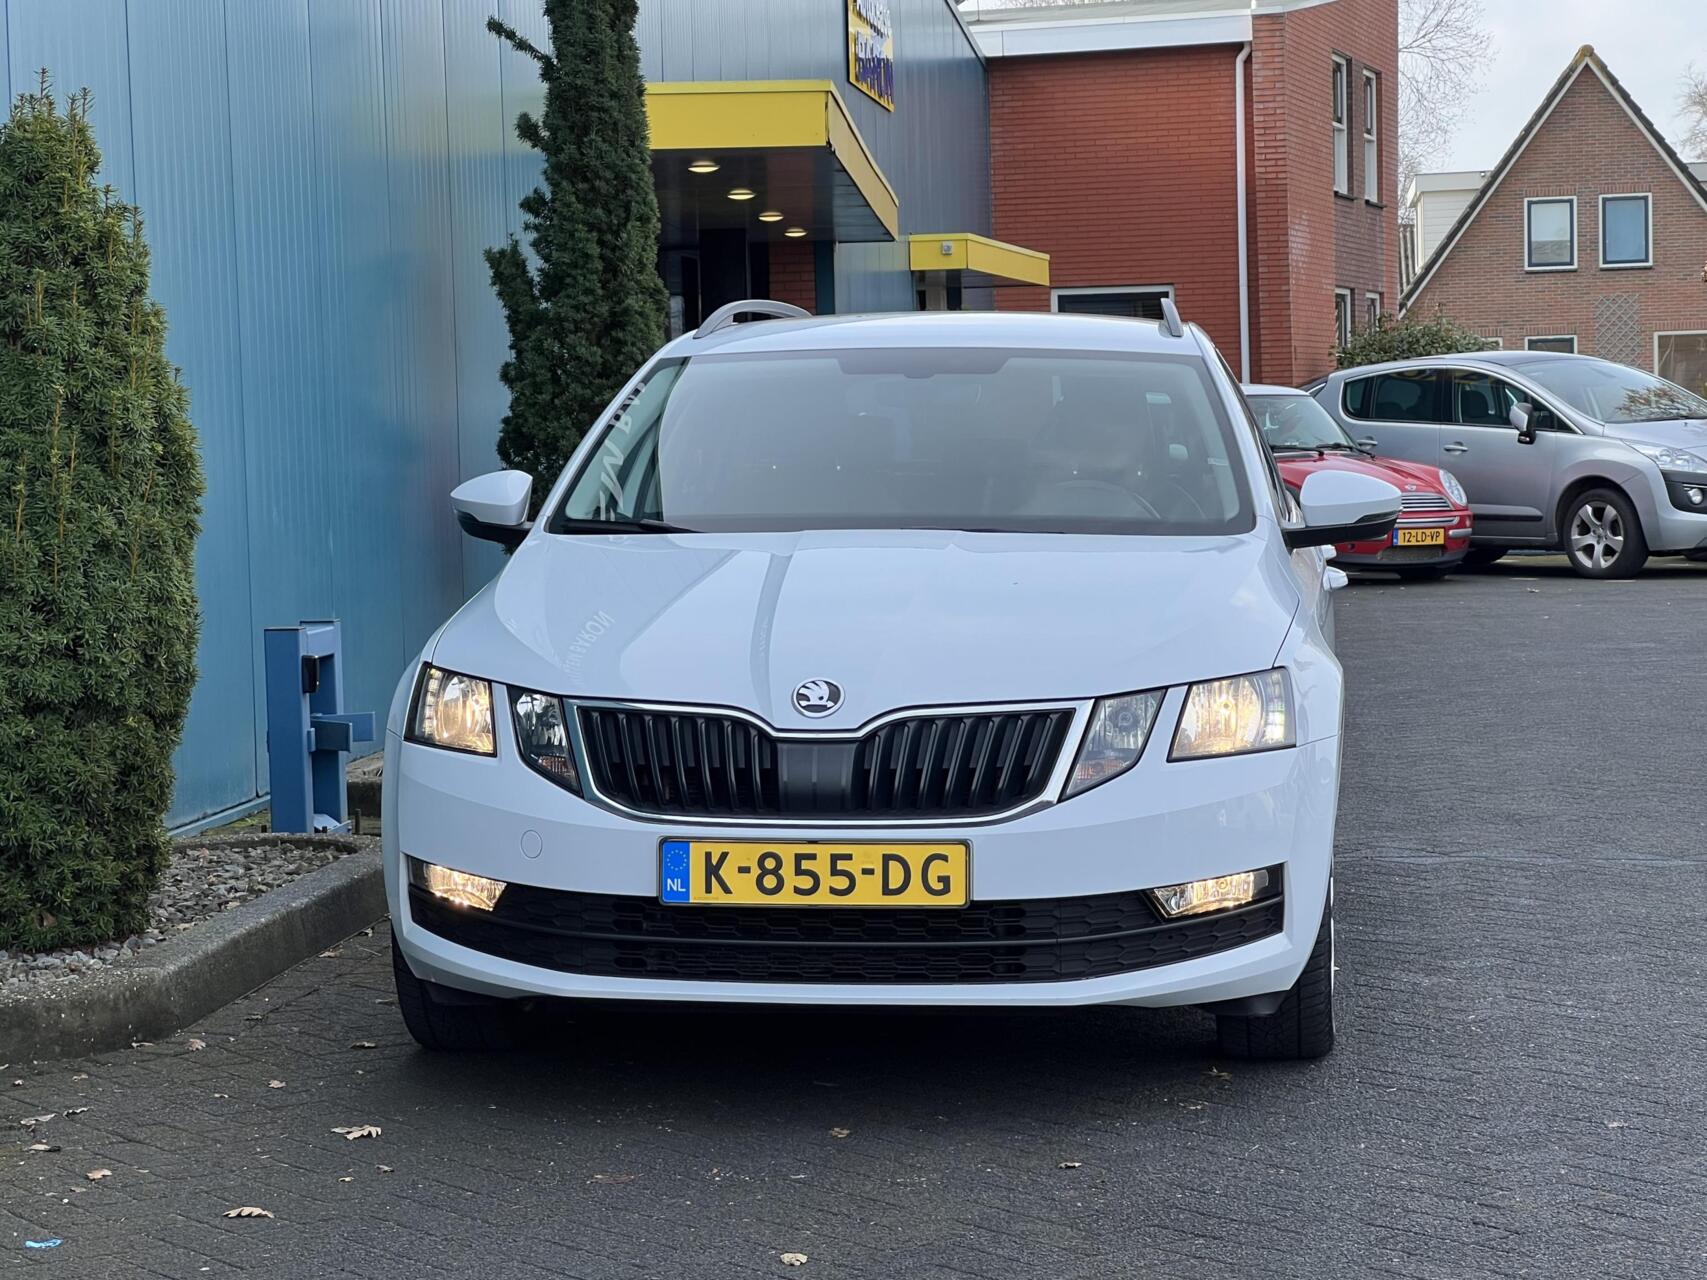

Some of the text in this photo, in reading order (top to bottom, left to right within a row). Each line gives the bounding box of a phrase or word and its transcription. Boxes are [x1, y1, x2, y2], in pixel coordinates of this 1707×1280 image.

[1402, 531, 1441, 543] 12-LD-VP
[703, 851, 951, 896] K-855-DG
[666, 879, 686, 892] NL
